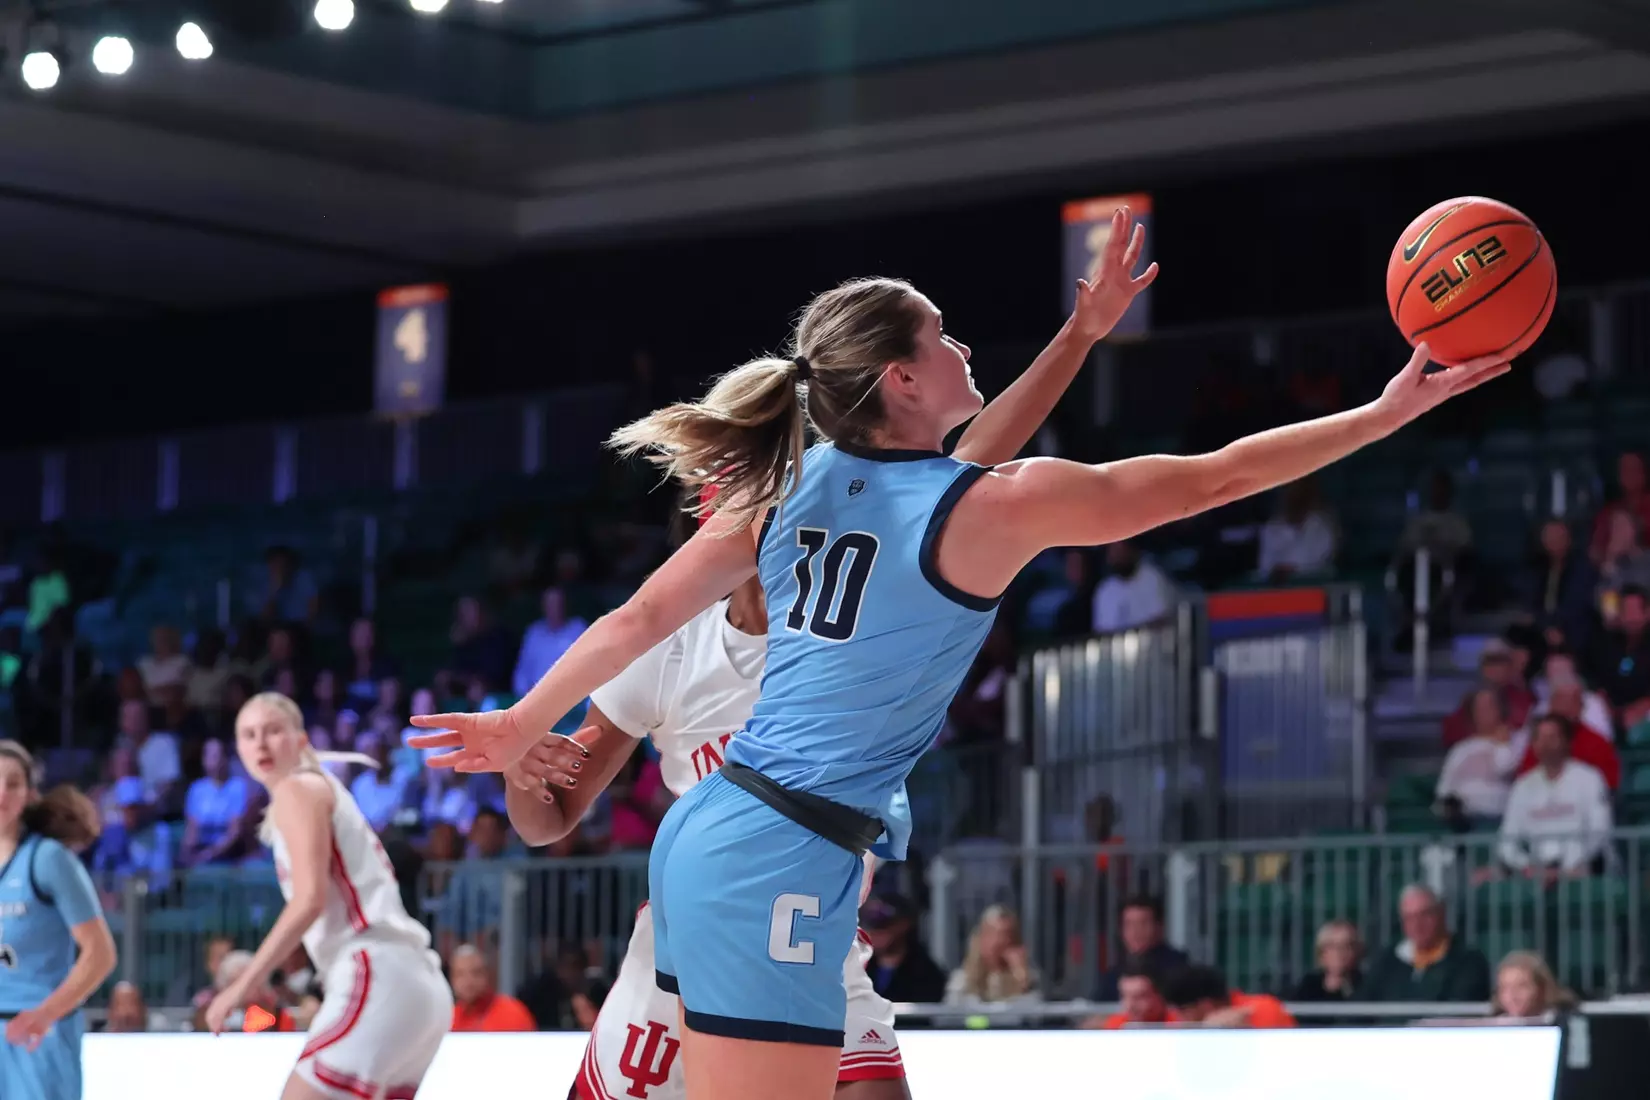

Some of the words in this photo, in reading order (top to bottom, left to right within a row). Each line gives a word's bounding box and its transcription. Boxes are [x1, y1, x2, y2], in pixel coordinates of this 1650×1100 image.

[1420, 235, 1508, 304] ELITE
[393, 307, 427, 364] 4
[785, 527, 880, 643] 10
[768, 892, 821, 965] C
